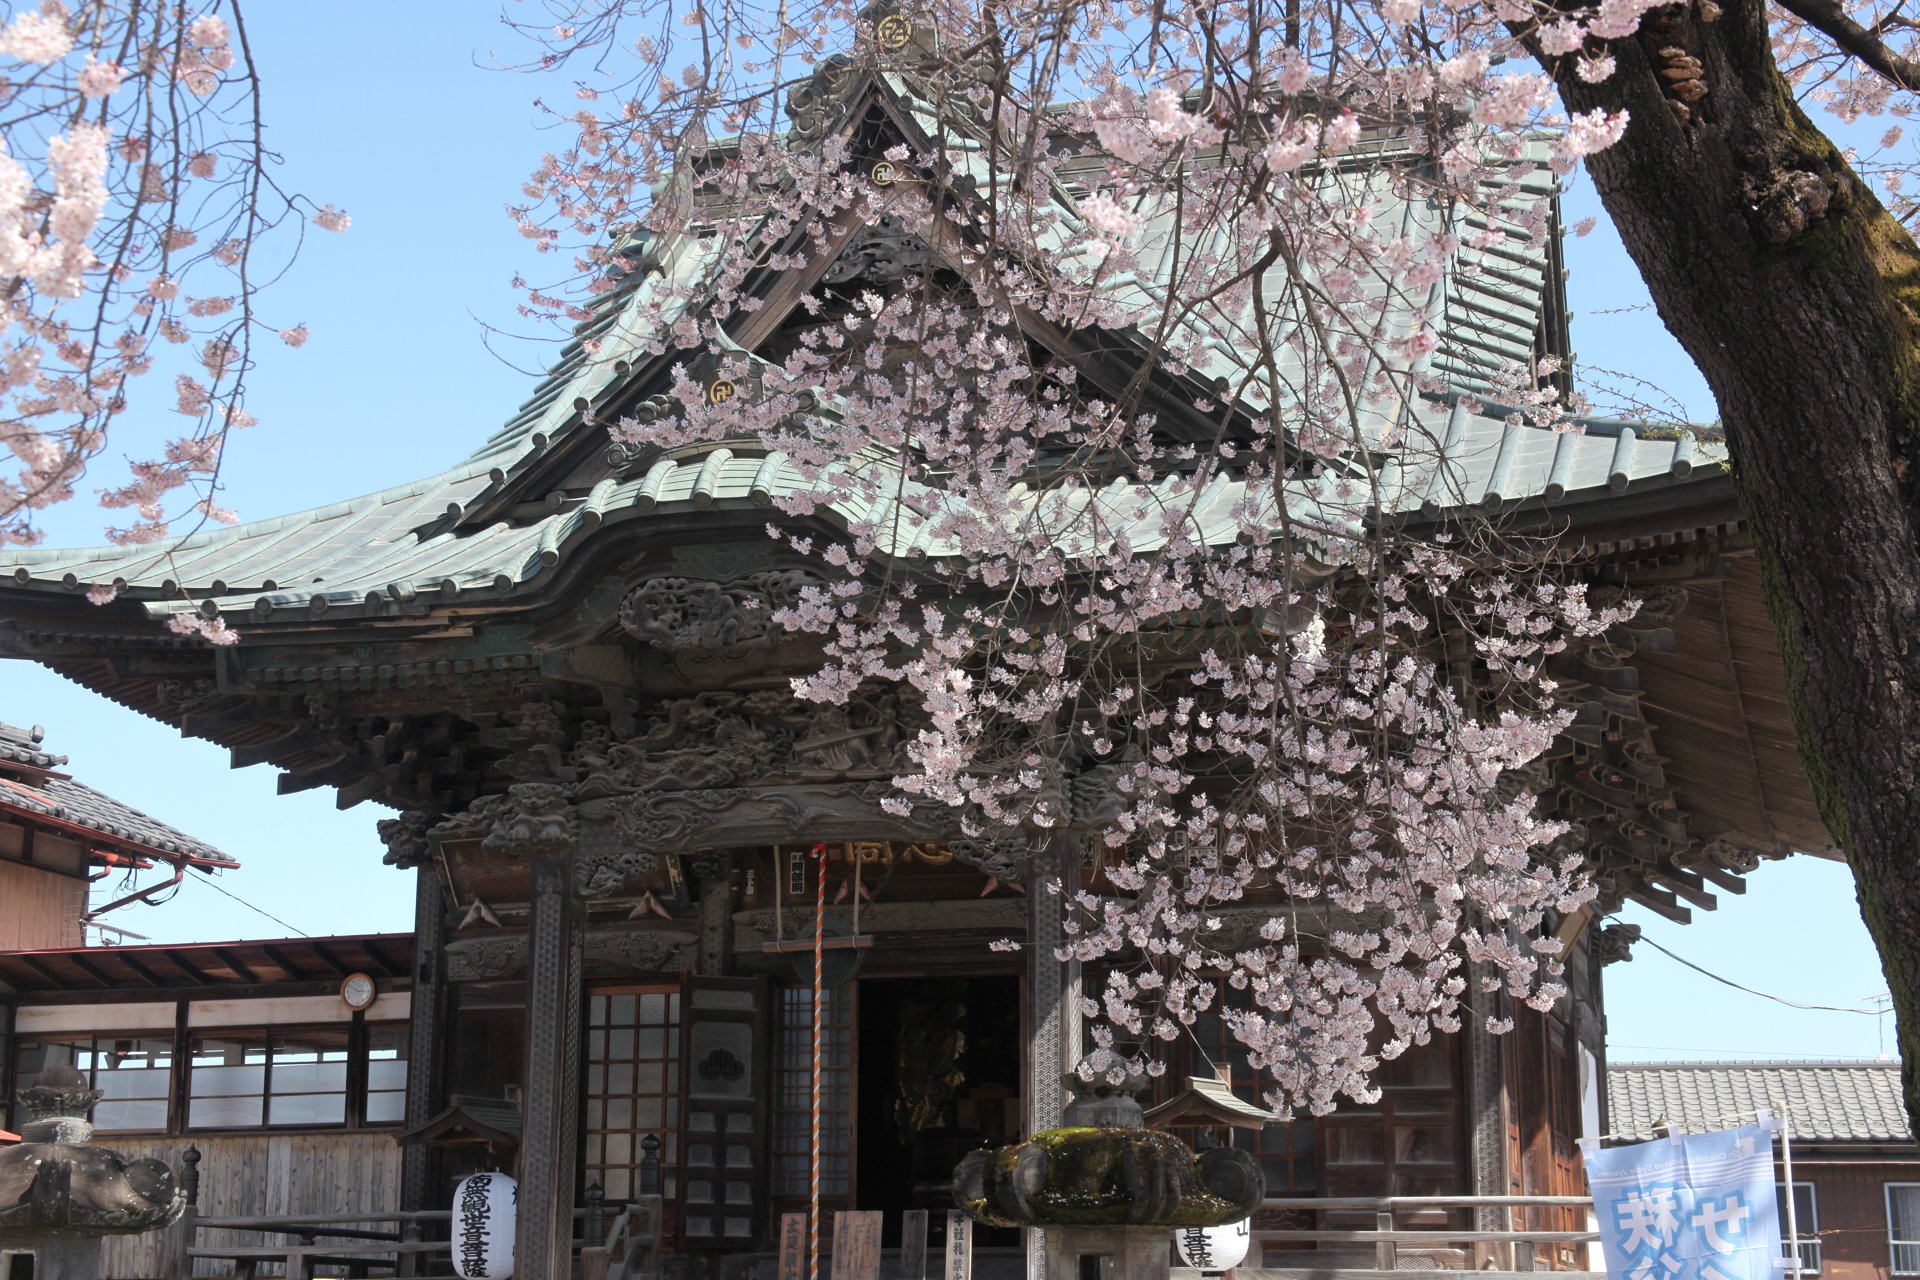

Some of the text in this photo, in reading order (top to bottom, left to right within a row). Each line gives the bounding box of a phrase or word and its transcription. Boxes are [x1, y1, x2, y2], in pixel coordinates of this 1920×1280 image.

[459, 1174, 493, 1278] 南無観世音菩薩
